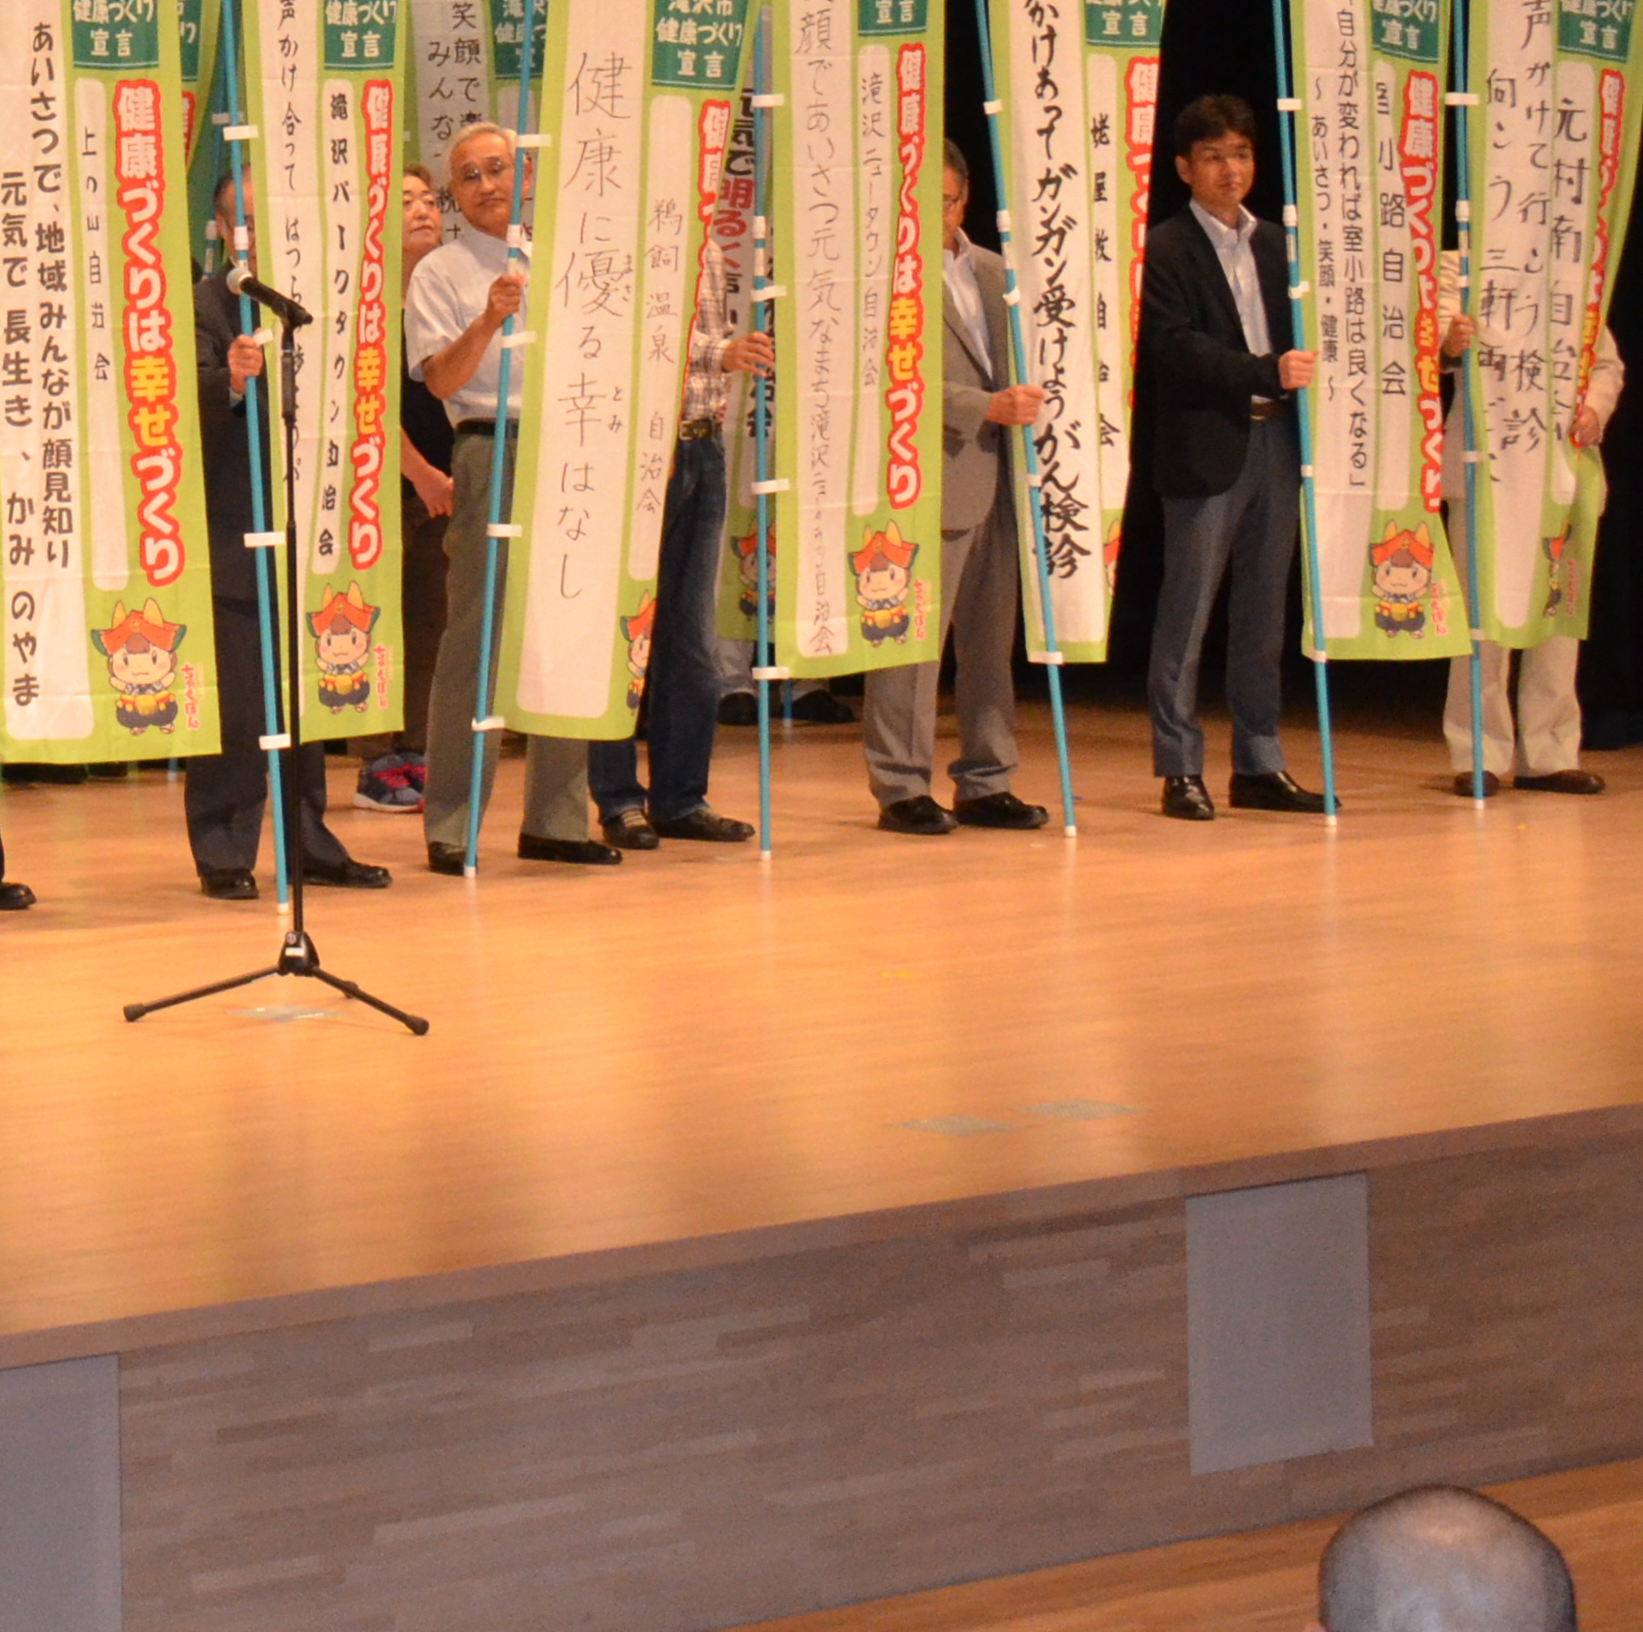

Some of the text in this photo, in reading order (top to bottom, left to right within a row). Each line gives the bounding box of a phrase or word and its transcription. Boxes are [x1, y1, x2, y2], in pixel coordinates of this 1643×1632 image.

[326, 1, 397, 24] 健康づくり
[1102, 12, 1148, 37] 宣言
[91, 29, 133, 57] 宣言
[341, 31, 380, 57] 宣言
[656, 20, 742, 47] 健康づくり
[888, 49, 924, 503] 健康づくりは幸せづくり
[118, 86, 182, 581] 健康づくりは幸せづくり
